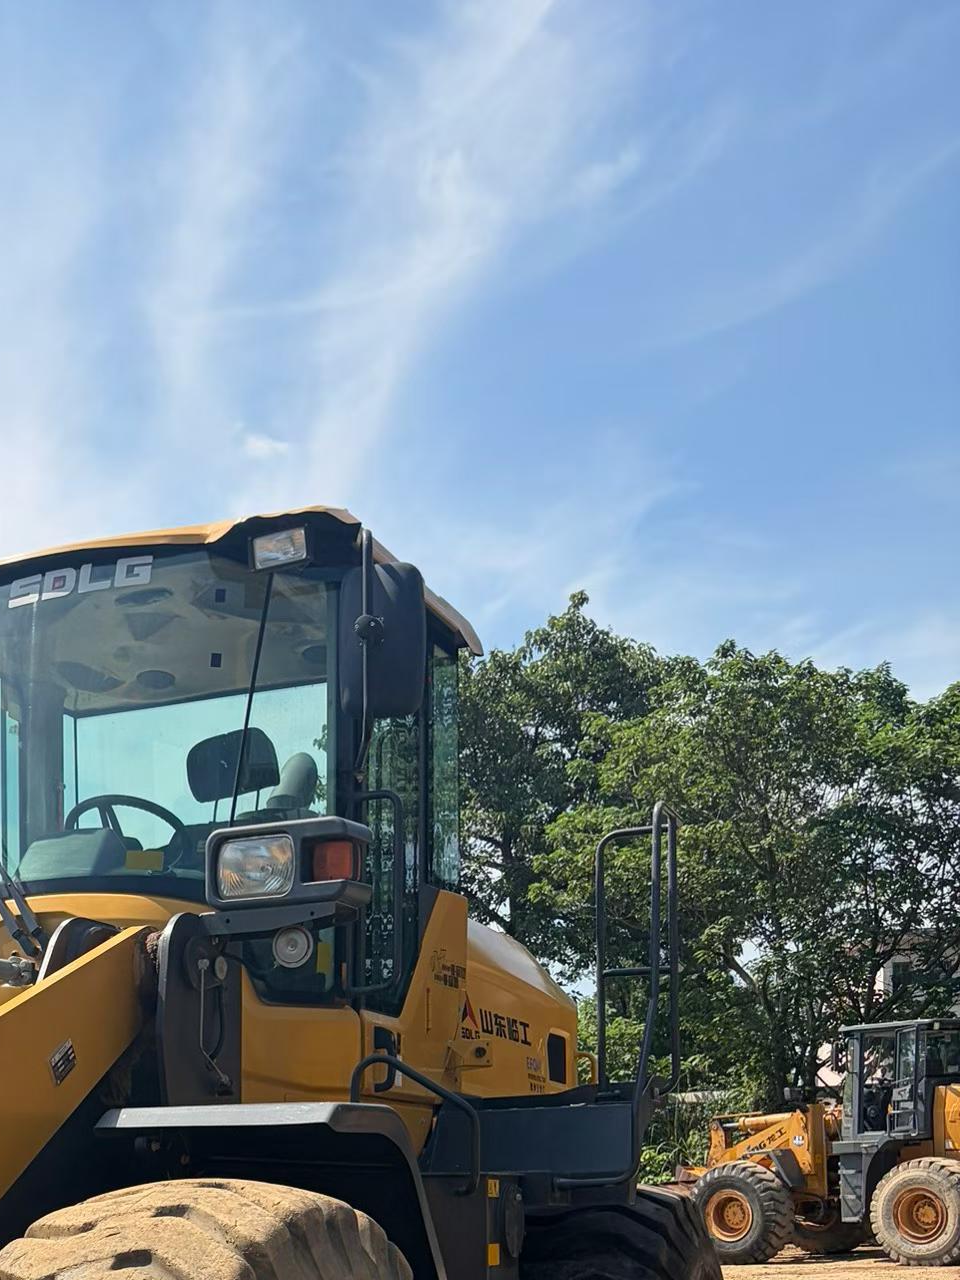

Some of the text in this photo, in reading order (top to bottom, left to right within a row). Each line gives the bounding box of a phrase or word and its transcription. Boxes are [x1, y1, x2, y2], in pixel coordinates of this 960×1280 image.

[8, 555, 153, 609] SDLG
[479, 1008, 532, 1047] 山东临工
